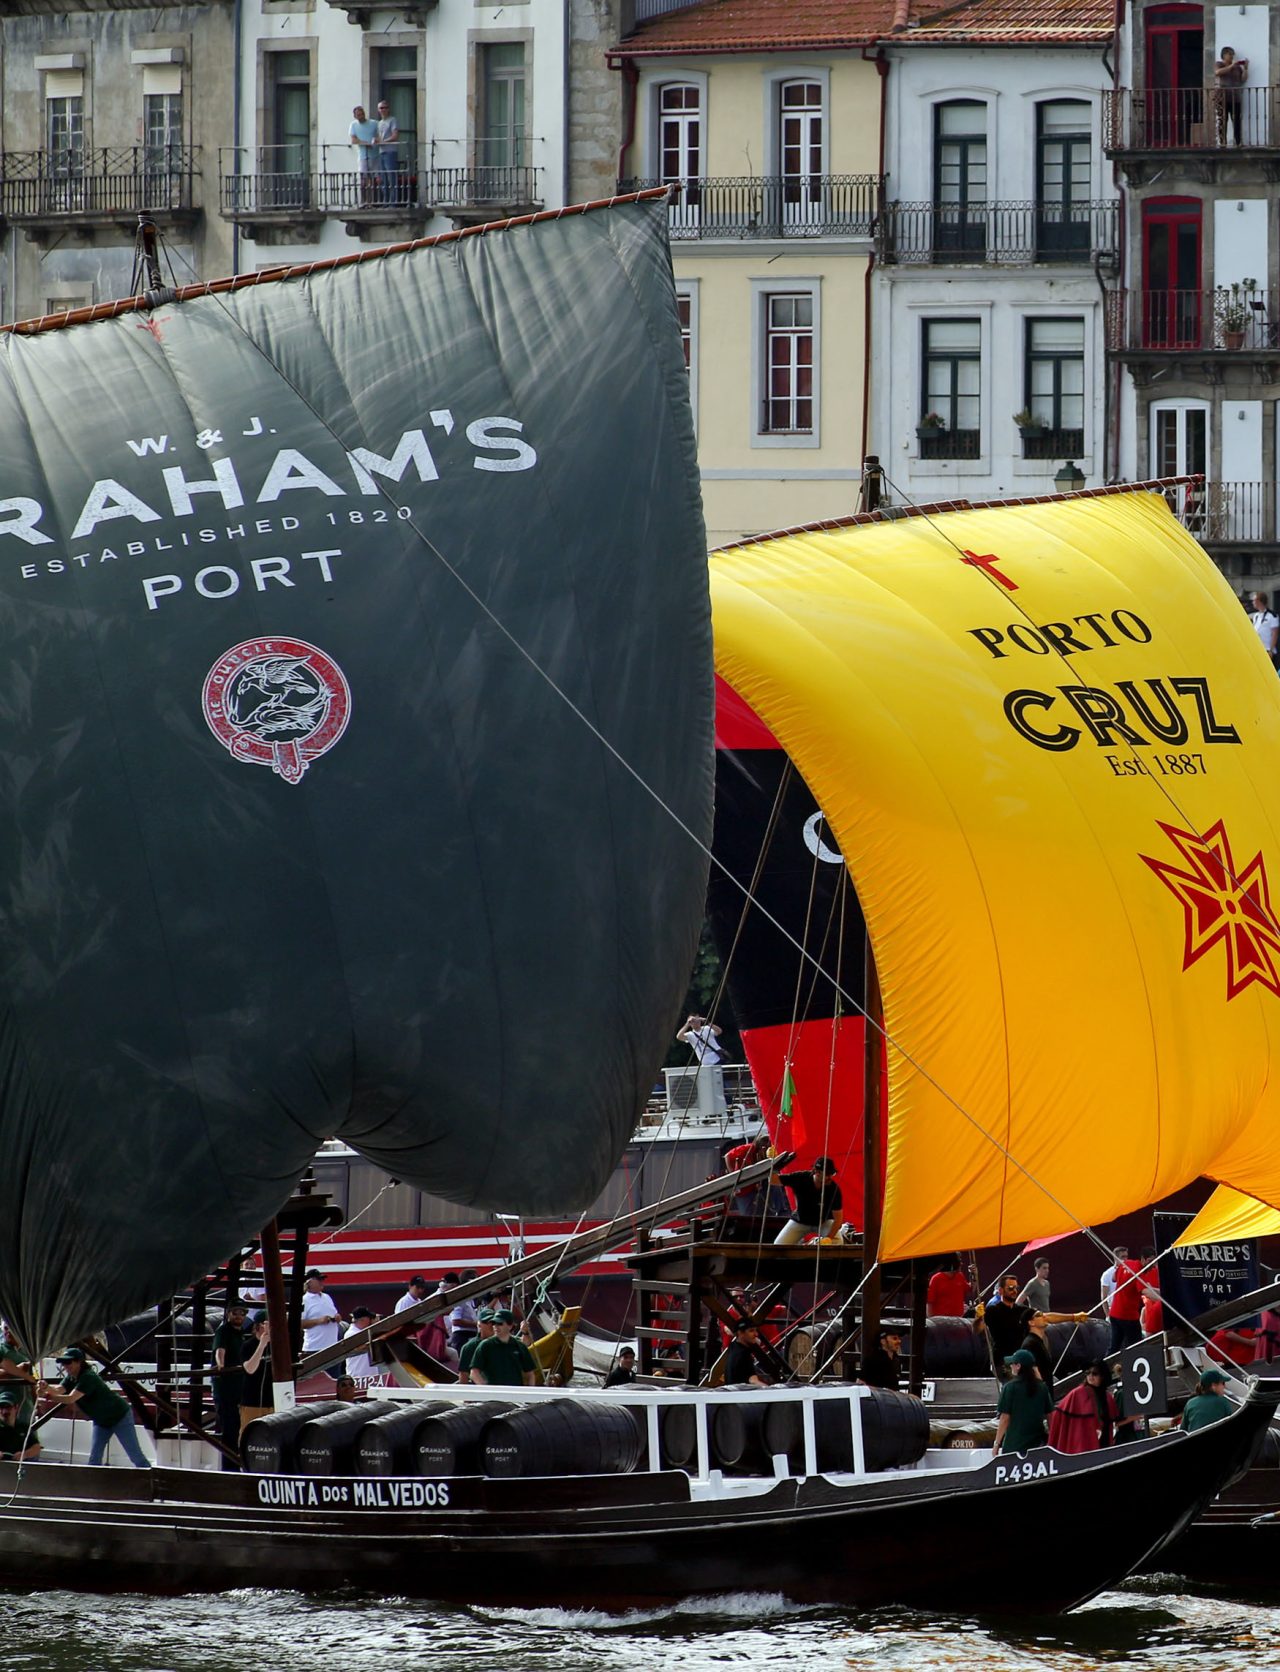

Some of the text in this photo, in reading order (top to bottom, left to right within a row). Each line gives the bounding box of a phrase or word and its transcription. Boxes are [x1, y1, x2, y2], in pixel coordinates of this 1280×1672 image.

[126, 416, 277, 457] W. & J.
[21, 505, 412, 579] ESTABLISHED 1820
[141, 549, 342, 611] PORT
[966, 609, 1152, 659] PORTO
[1003, 676, 1243, 752] CRUZ
[1153, 753, 1207, 776] 1887
[1173, 1244, 1251, 1262] WARRE'S
[1203, 1283, 1232, 1294] PORT
[1132, 1357, 1154, 1405] 3
[951, 1439, 974, 1448] PORTO
[258, 1479, 449, 1507] QUINTA DOS MALVEDOS
